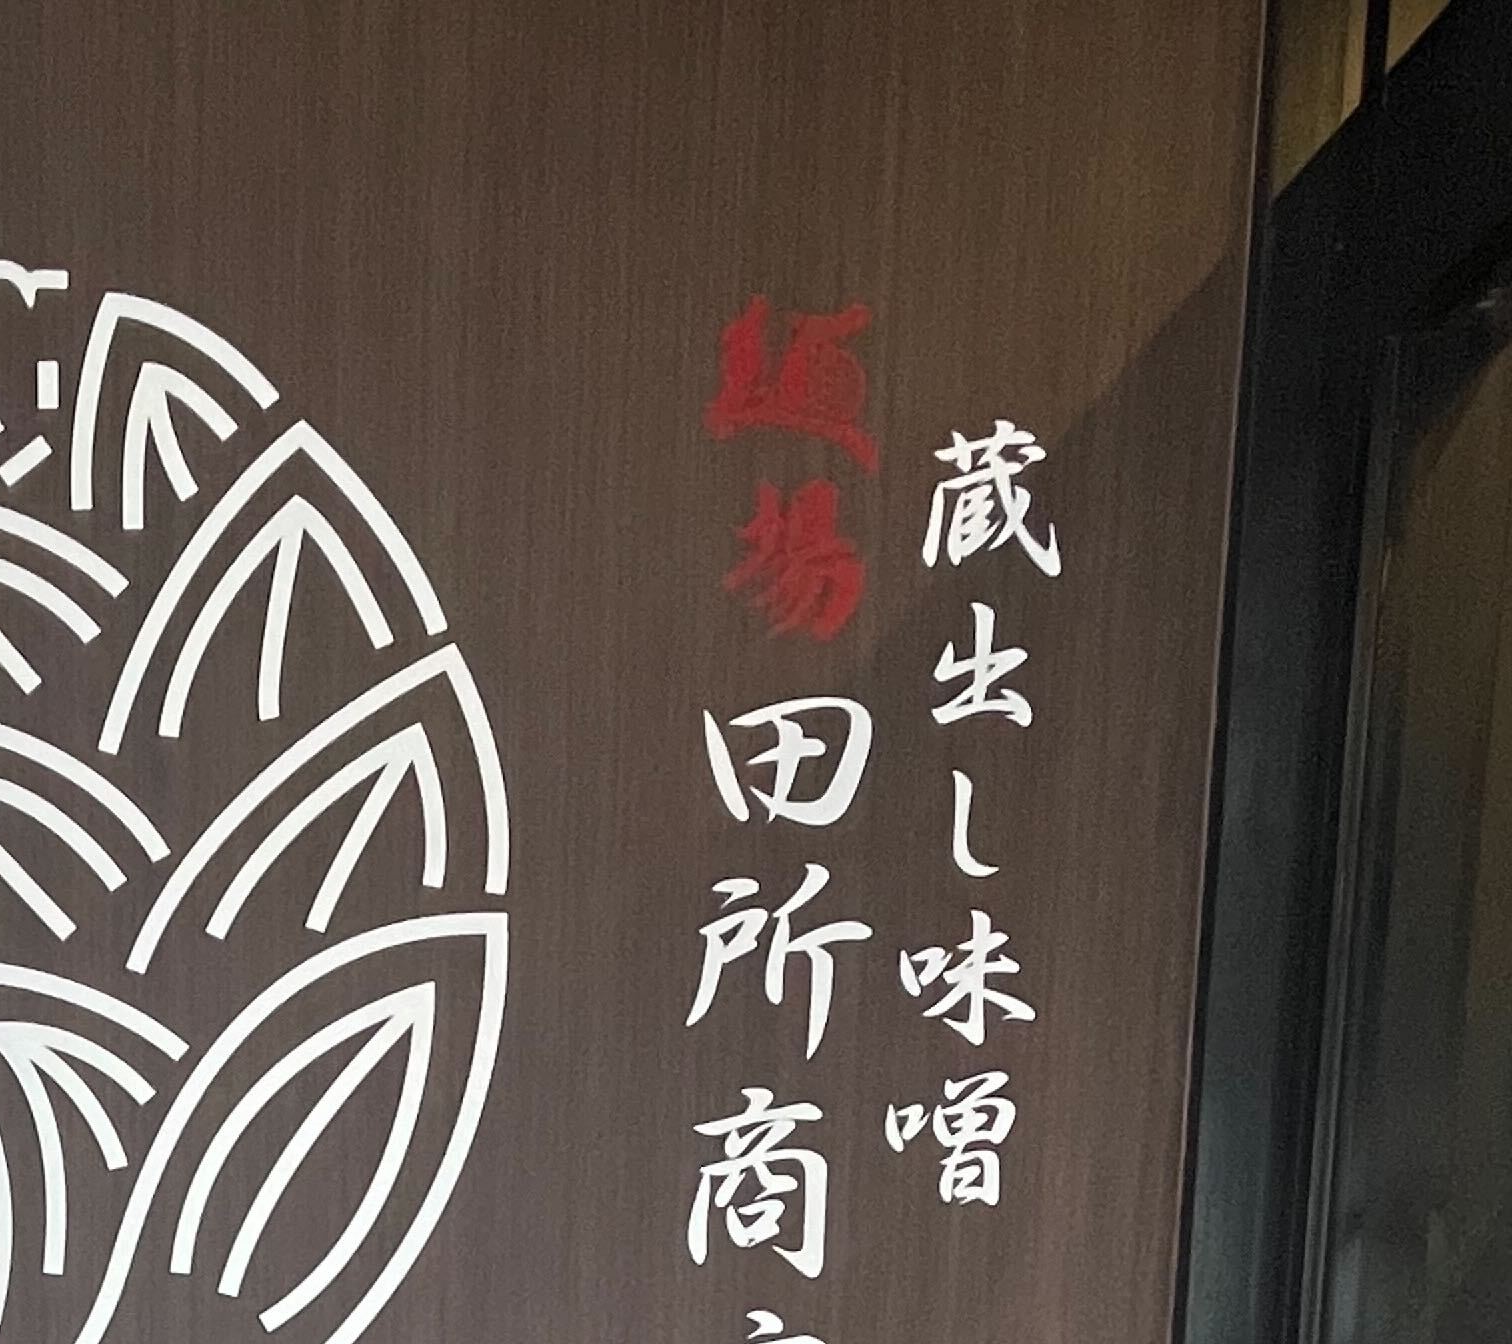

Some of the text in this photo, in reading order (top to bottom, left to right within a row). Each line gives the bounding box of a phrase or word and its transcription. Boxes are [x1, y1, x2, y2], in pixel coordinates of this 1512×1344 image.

[885, 420, 1064, 1208] 蔵出し味噌
